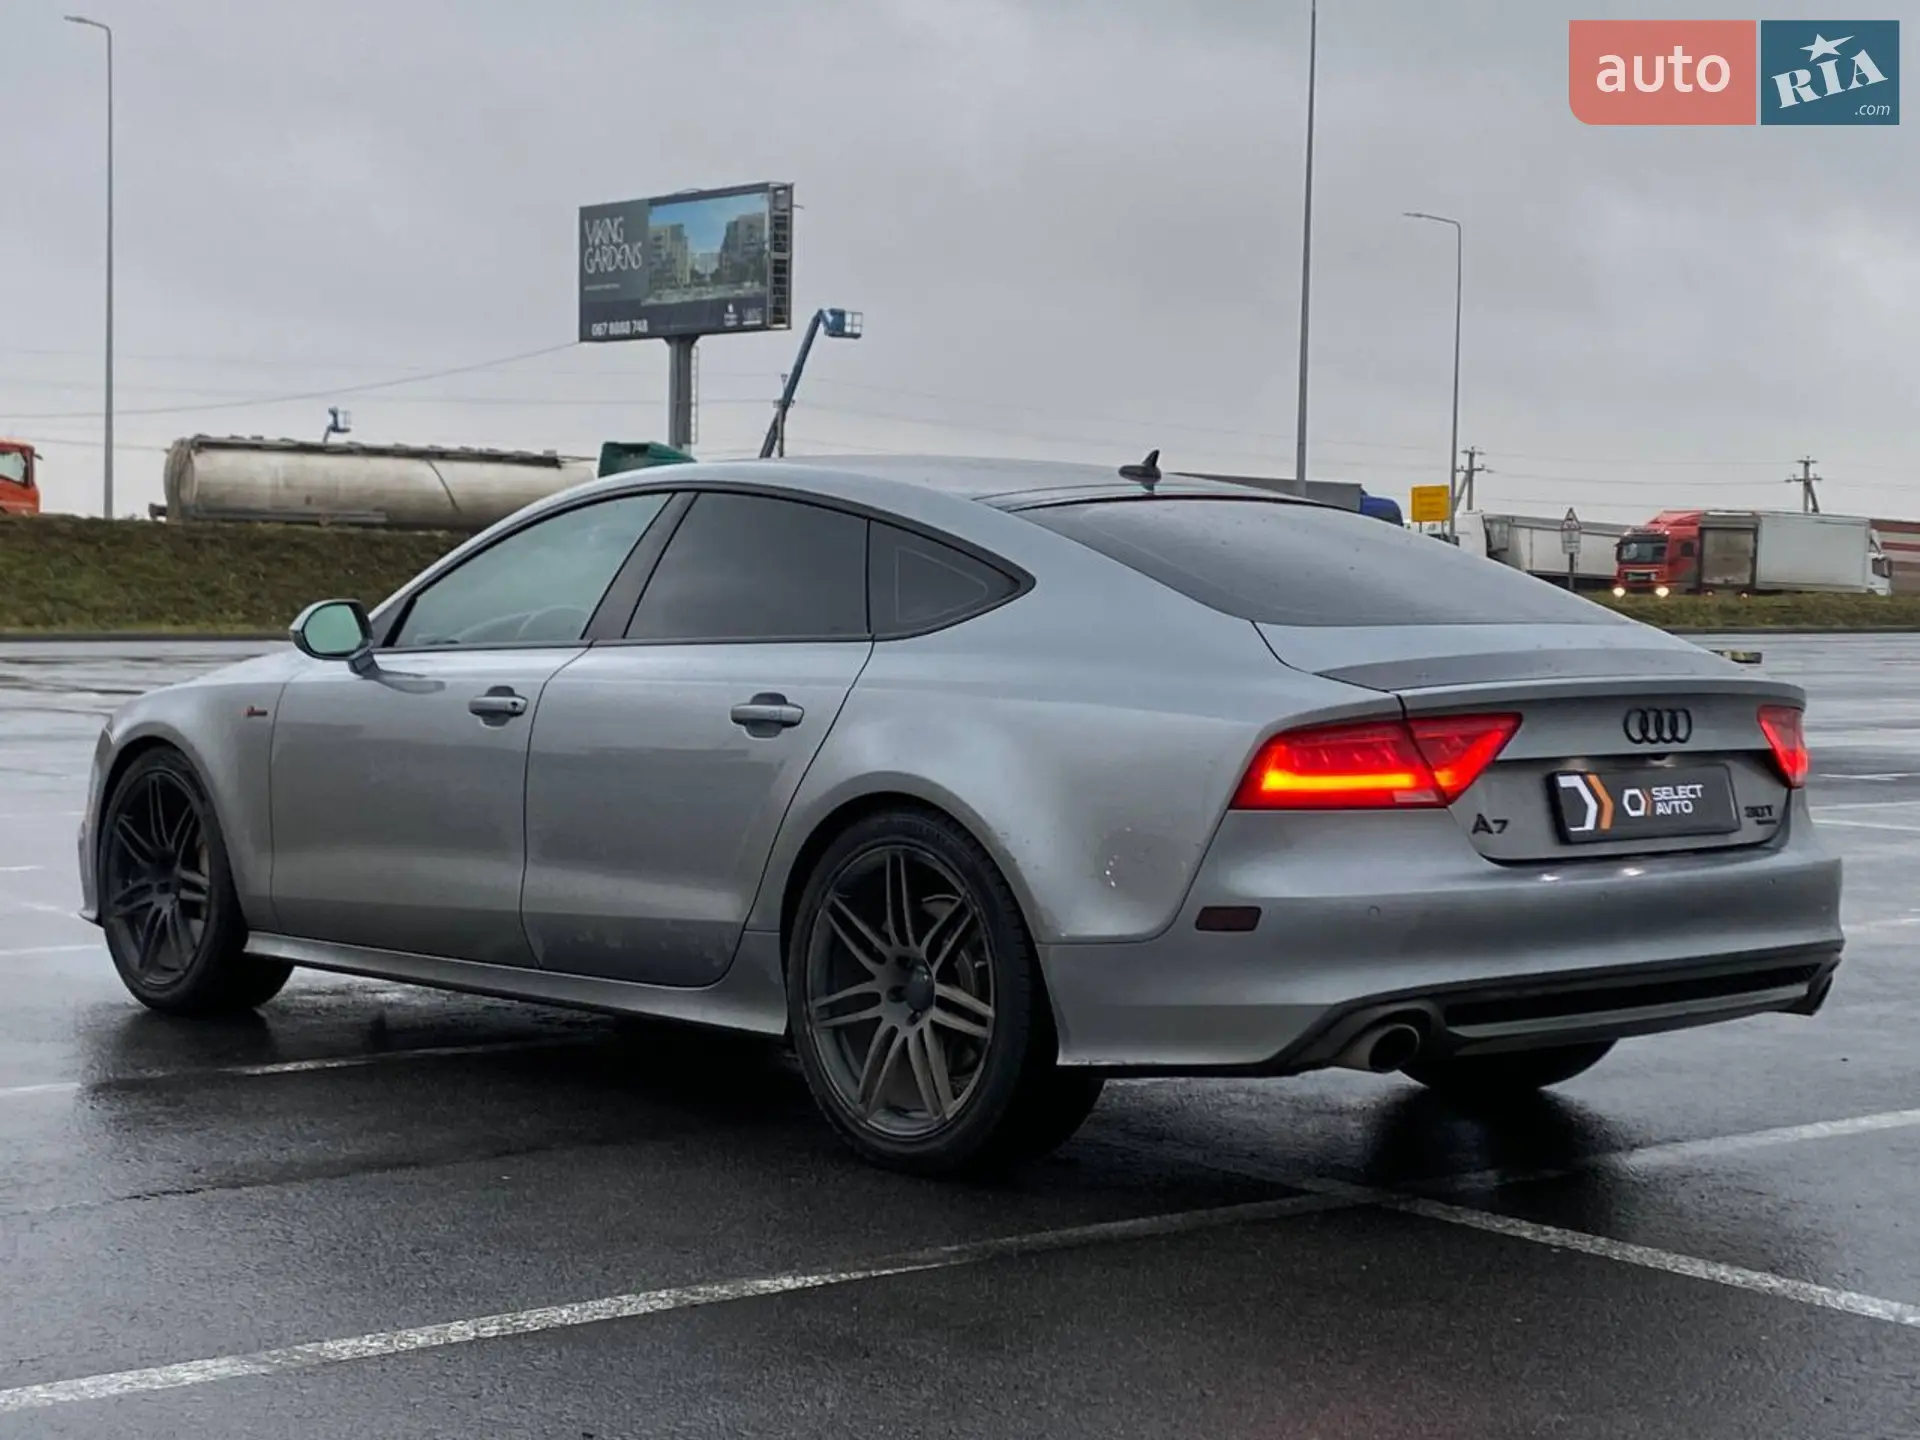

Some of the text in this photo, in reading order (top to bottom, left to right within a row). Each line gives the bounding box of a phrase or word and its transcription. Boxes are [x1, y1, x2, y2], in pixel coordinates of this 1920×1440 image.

[584, 242, 642, 274] GARDENS
[1651, 784, 1704, 800] SELECT
[1655, 800, 1694, 816] AVTO
[1471, 812, 1509, 835] A7
